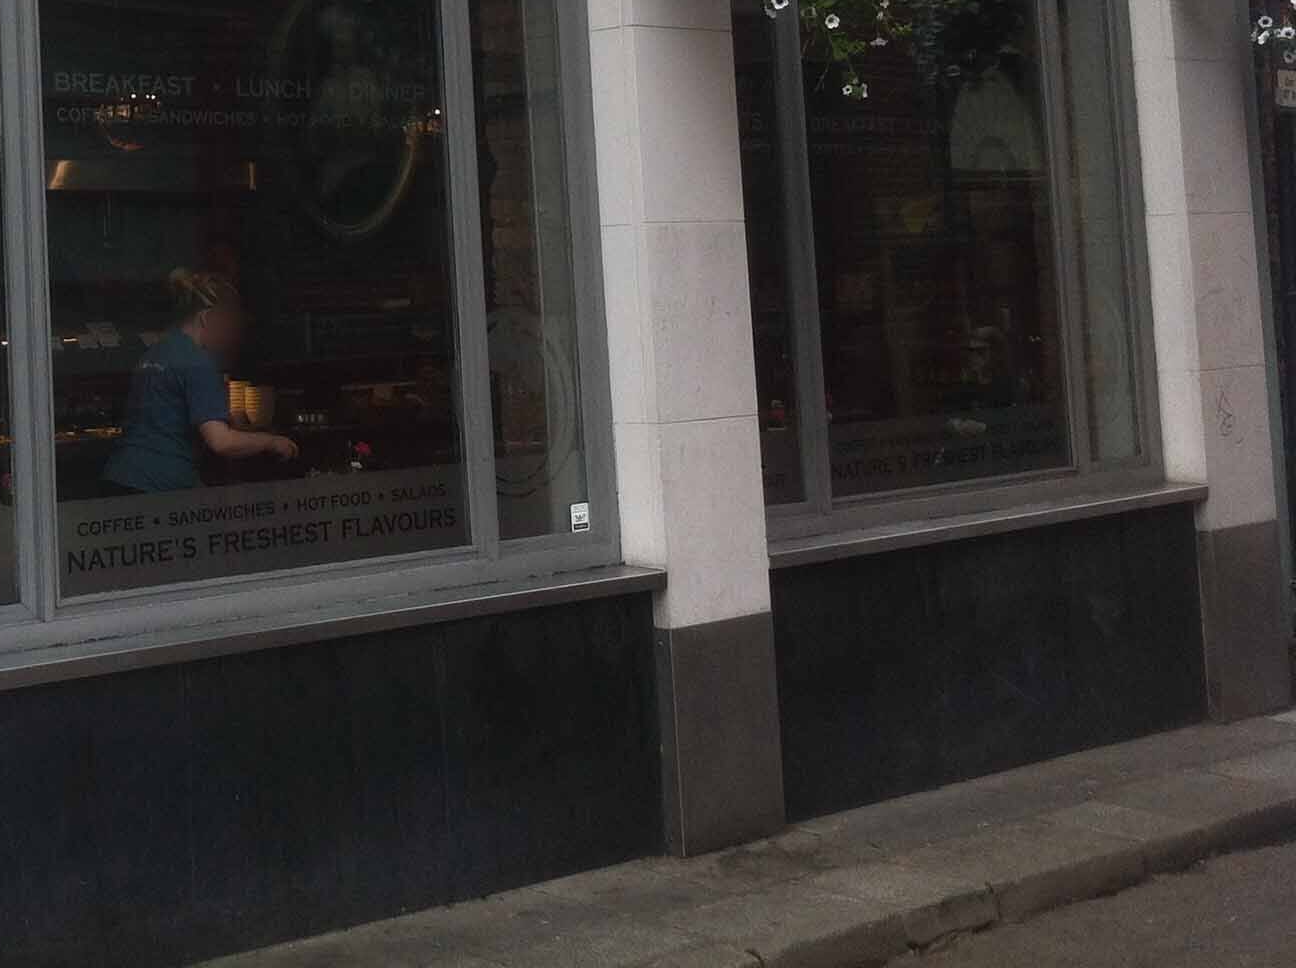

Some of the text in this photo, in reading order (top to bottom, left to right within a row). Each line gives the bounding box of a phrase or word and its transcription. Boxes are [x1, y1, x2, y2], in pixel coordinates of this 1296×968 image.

[55, 72, 197, 97] BREAKFAST
[235, 78, 312, 100] LUNCH
[78, 482, 447, 537] COFFEE SANDWICHES HOT FOOD SALADS
[68, 507, 457, 575] NATURE'S FRESHEST FLAVOURS
